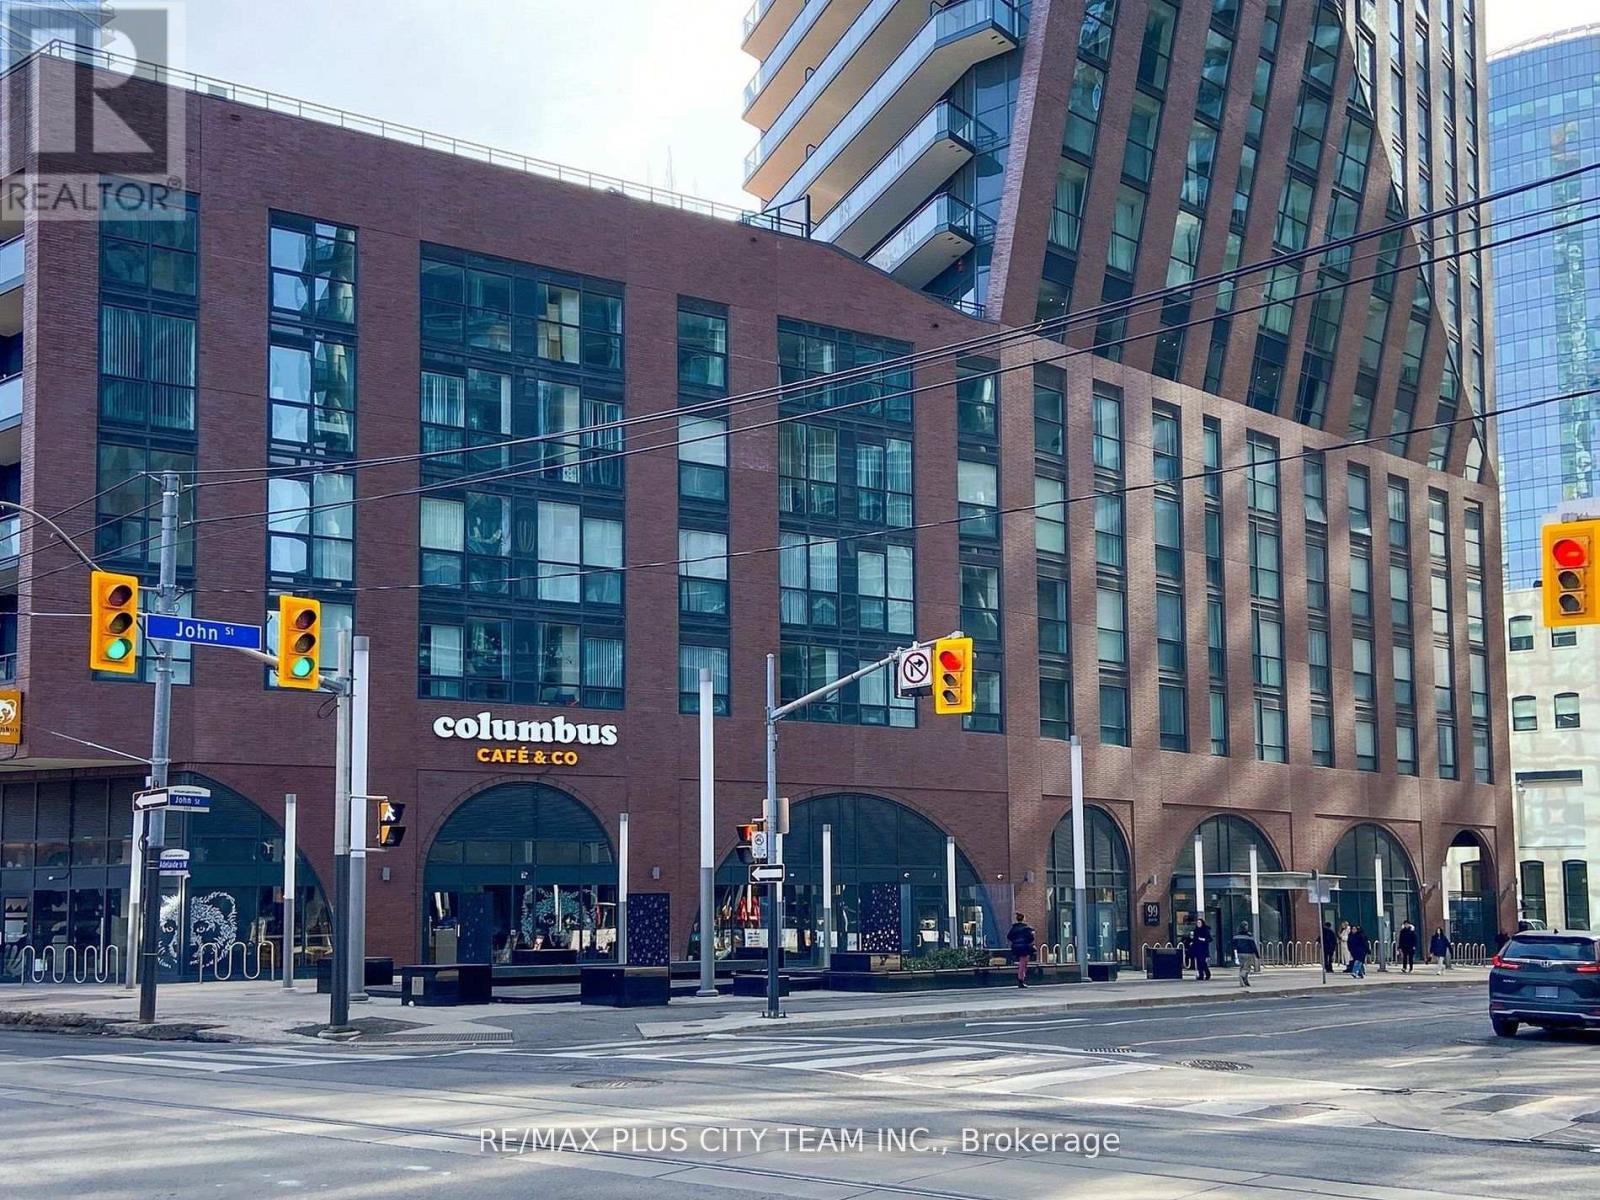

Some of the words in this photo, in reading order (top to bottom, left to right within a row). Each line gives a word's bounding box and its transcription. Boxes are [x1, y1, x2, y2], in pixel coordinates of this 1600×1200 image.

[176, 621, 218, 641] John
[225, 627, 235, 637] St
[432, 711, 618, 746] columbus
[476, 746, 530, 764] CAFÉ
[534, 751, 547, 765] &
[551, 751, 579, 766] CO
[175, 796, 192, 805] John
[1147, 904, 1158, 917] 99
